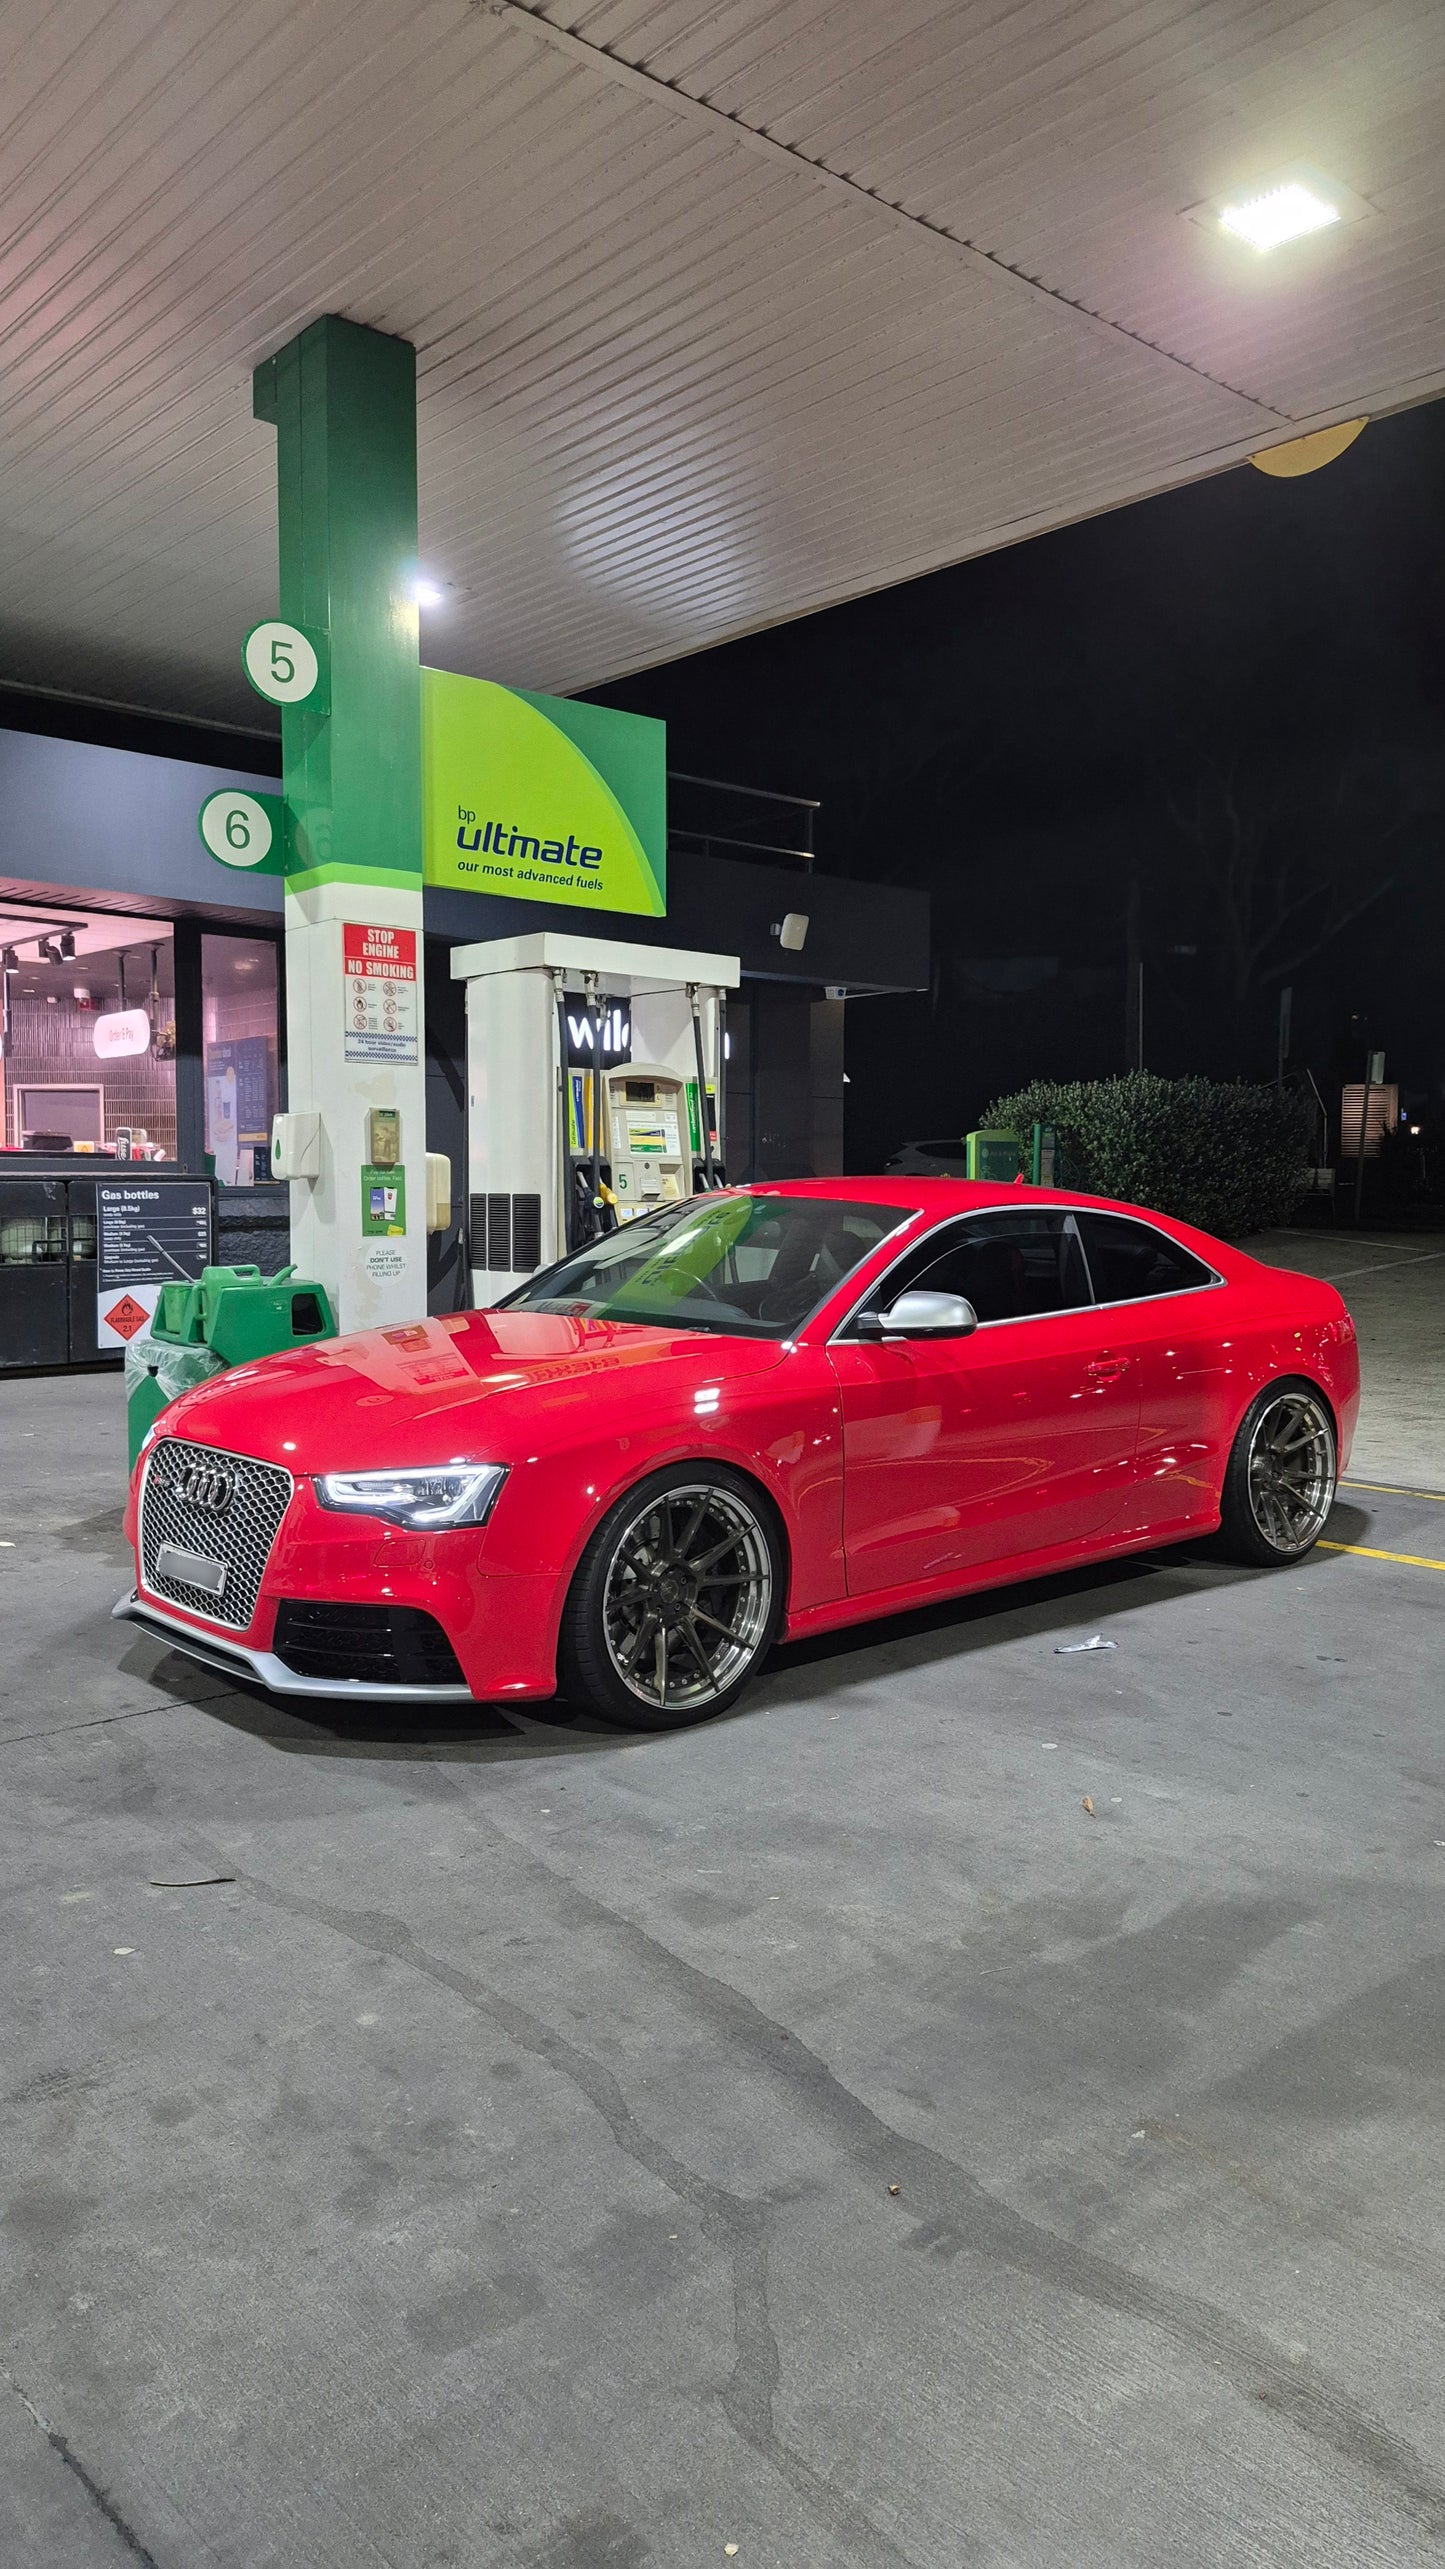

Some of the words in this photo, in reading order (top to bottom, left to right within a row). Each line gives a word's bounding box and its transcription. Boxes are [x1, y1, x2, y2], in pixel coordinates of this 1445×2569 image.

[270, 640, 295, 683] 5
[458, 805, 476, 824] bp
[225, 809, 251, 850] 6
[457, 821, 603, 869] ultimate
[458, 861, 479, 872] our
[482, 864, 513, 877] most
[517, 869, 573, 886] advanced
[576, 875, 604, 891] fuels
[367, 929, 395, 944] STOP
[362, 942, 399, 959] ENGINE
[348, 959, 363, 974] NO
[366, 961, 414, 980] SMOKING
[618, 1174, 628, 1189] 5
[101, 1190, 122, 1200] Gas
[123, 1190, 160, 1200] bottles
[192, 1207, 206, 1215] $32
